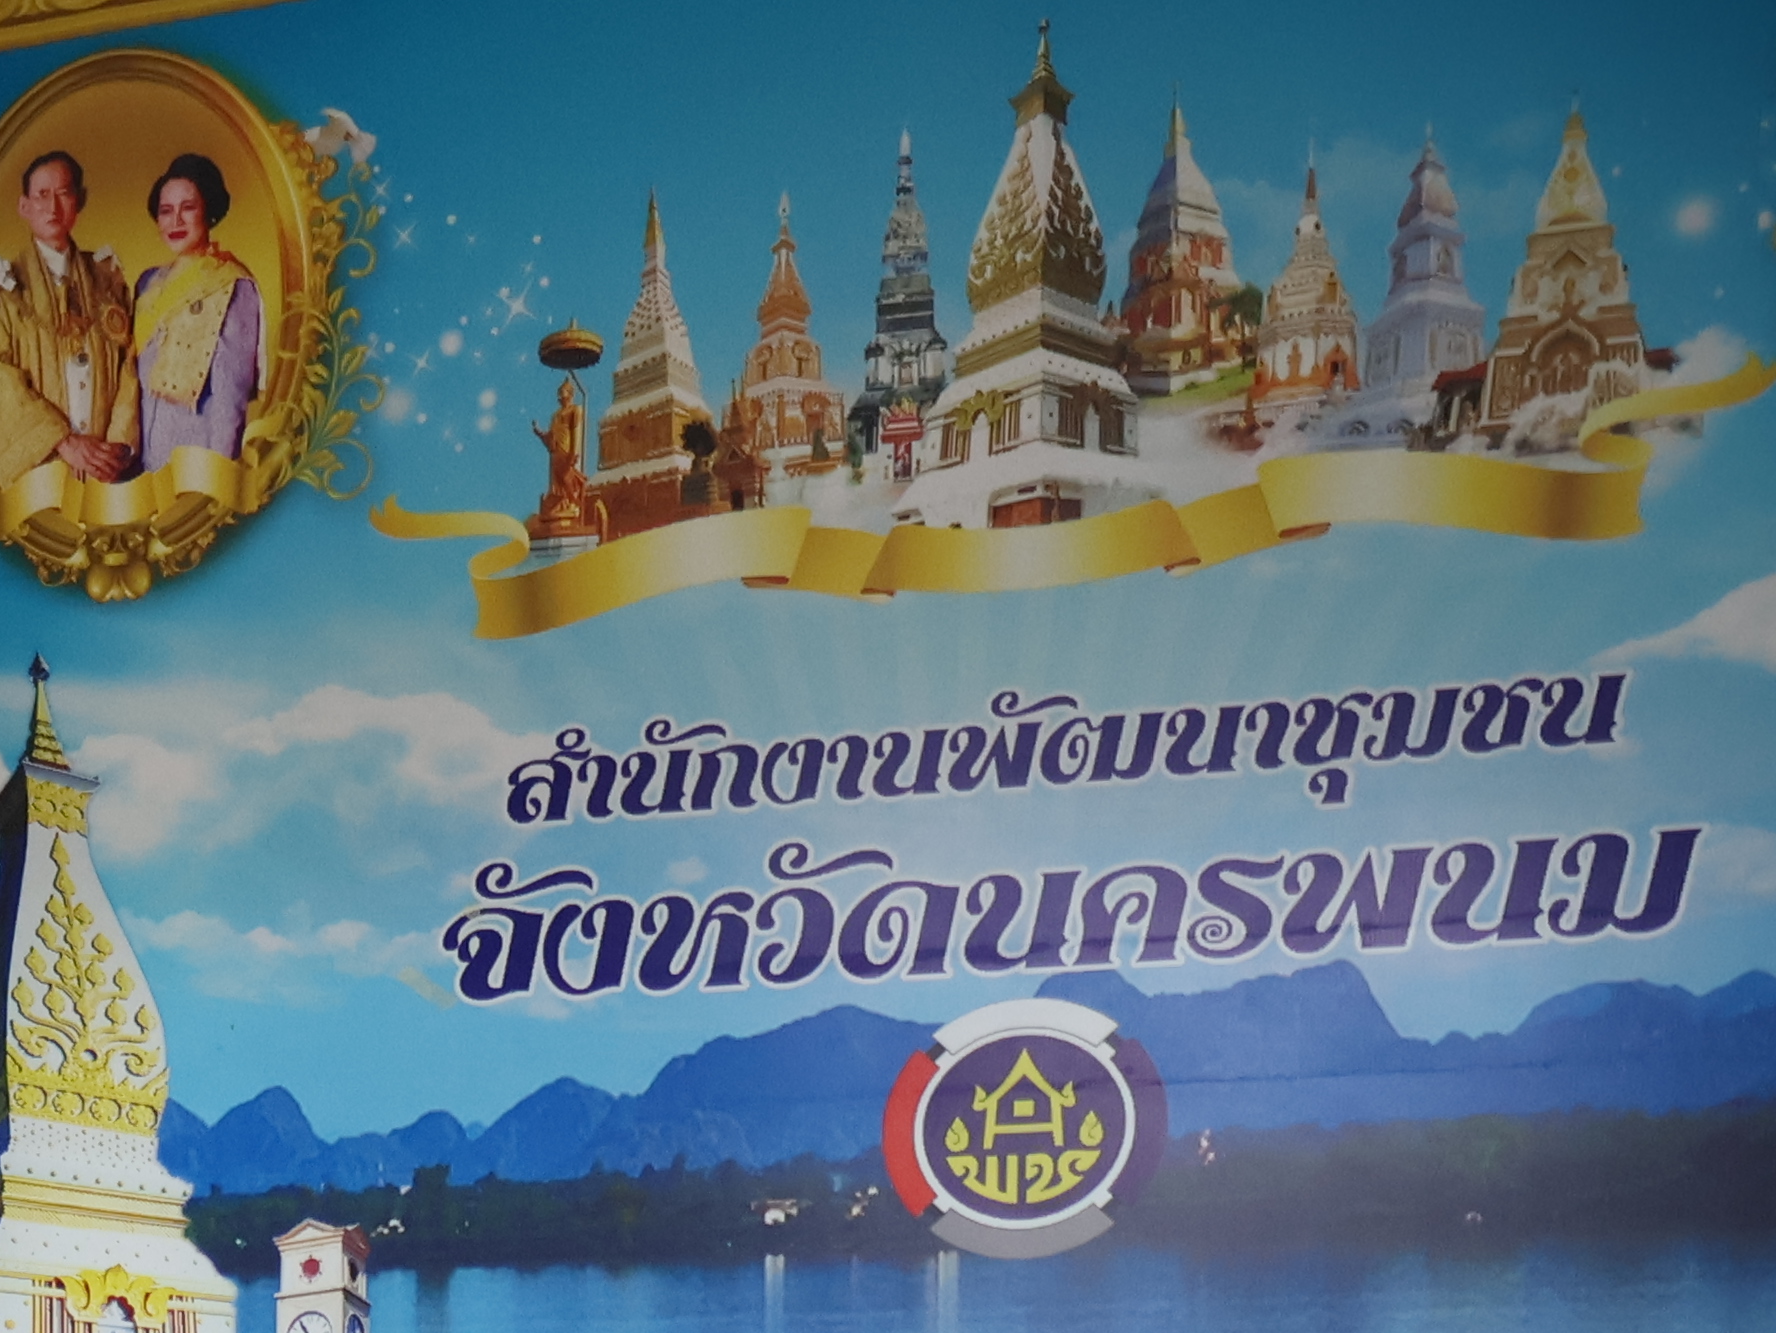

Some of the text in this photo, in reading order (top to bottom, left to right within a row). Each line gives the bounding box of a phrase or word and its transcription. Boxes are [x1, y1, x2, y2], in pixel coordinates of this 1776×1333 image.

[504, 670, 1630, 828] สำนักงานพัฒนาชุมชน
[440, 824, 1705, 1004] จังหวัดนครพนม
